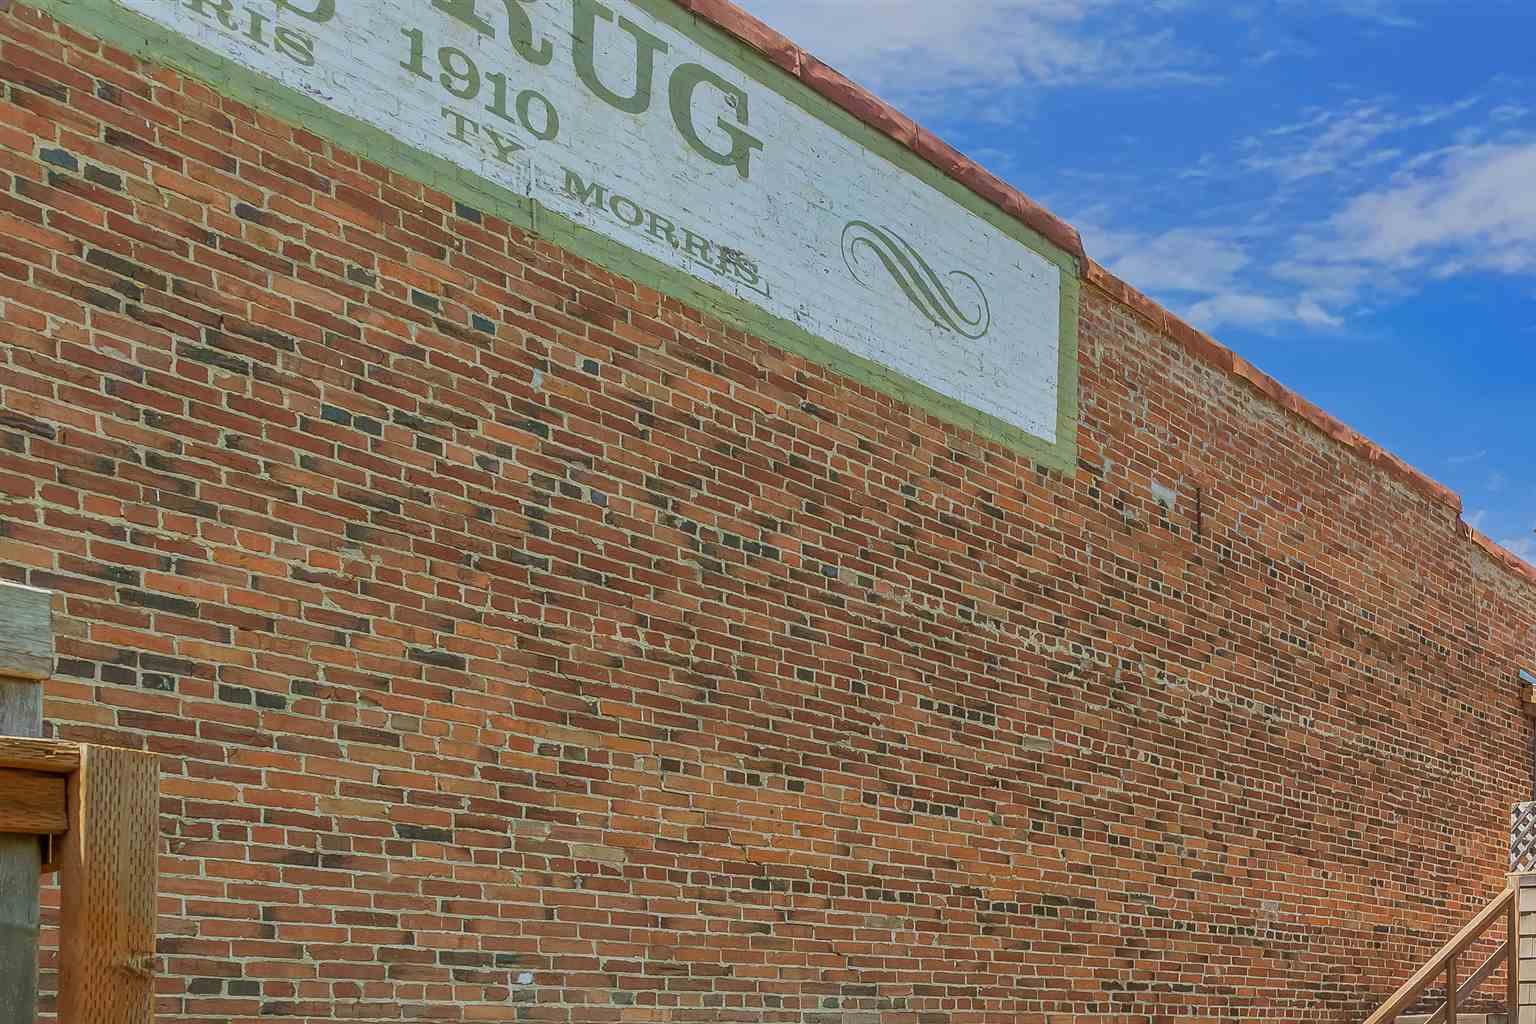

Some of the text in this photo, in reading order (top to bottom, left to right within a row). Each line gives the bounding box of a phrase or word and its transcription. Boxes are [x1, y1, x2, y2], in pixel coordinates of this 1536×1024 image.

[400, 27, 560, 142] 1910
[441, 105, 759, 285] TY MORRIS
